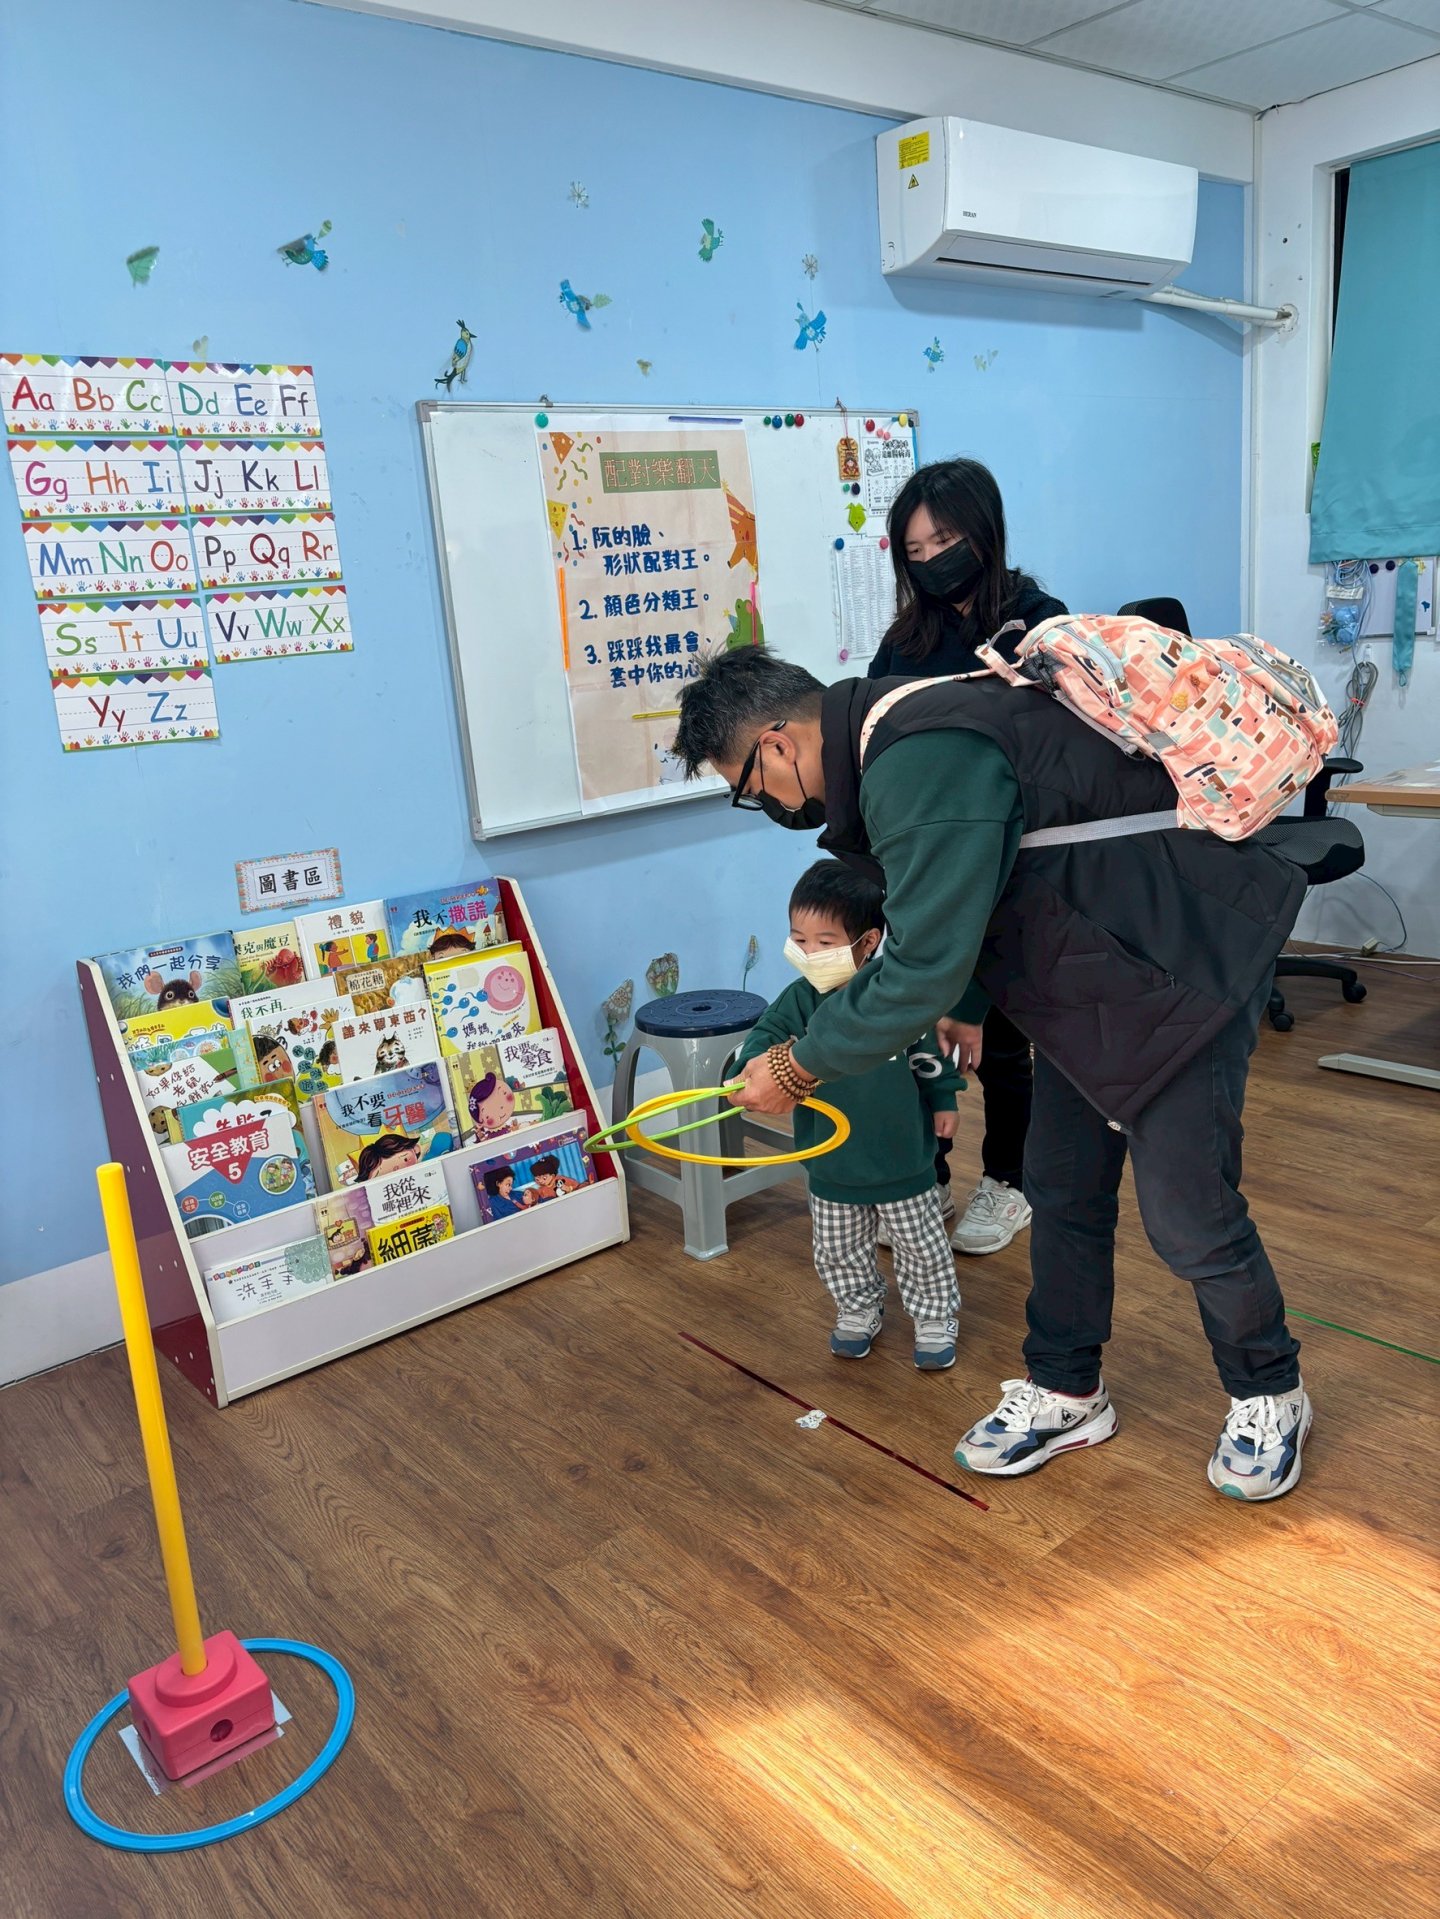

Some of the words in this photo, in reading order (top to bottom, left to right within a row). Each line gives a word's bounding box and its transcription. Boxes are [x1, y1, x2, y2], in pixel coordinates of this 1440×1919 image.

[12, 375, 55, 411] Aa
[72, 377, 115, 412] Bb
[125, 379, 164, 413] Cc
[178, 382, 220, 416] Dd
[234, 383, 268, 417] Ee
[279, 384, 308, 417] Ff
[25, 461, 69, 503] Gg
[85, 461, 130, 494] Hh
[142, 461, 173, 494] Ii
[194, 459, 224, 499] Jj
[242, 460, 281, 492] Kk
[293, 459, 320, 491] Ll
[603, 456, 719, 488] 配對樂翻天
[204, 535, 236, 573] Pp
[249, 532, 291, 569] Qq
[301, 530, 334, 561] Rr
[572, 530, 587, 551] 1.
[39, 542, 93, 577] Mm
[99, 541, 144, 574] Nn
[150, 540, 189, 572] Oo
[602, 548, 710, 577] 形狀配對王。
[578, 599, 598, 620] 2.
[603, 588, 710, 618] 顏色分類王。
[56, 622, 98, 656] Ss
[108, 621, 144, 652] Tt
[157, 618, 198, 649] Uu
[215, 610, 250, 642] Vv
[255, 606, 302, 638] Ww
[308, 603, 346, 634] Xx
[584, 644, 602, 665] 3.
[88, 695, 126, 733] Yy
[146, 692, 189, 723] Zz
[258, 866, 323, 895] 圖書區
[327, 910, 366, 930] 禮貌
[412, 900, 489, 928] 我不撒謊
[116, 954, 221, 990] 我們一起分享
[341, 1091, 386, 1118] 我不要
[367, 1101, 428, 1128] 看牙醫
[189, 1129, 269, 1170] 安全教育
[228, 1162, 242, 1180] 5
[383, 1175, 417, 1201] 我從
